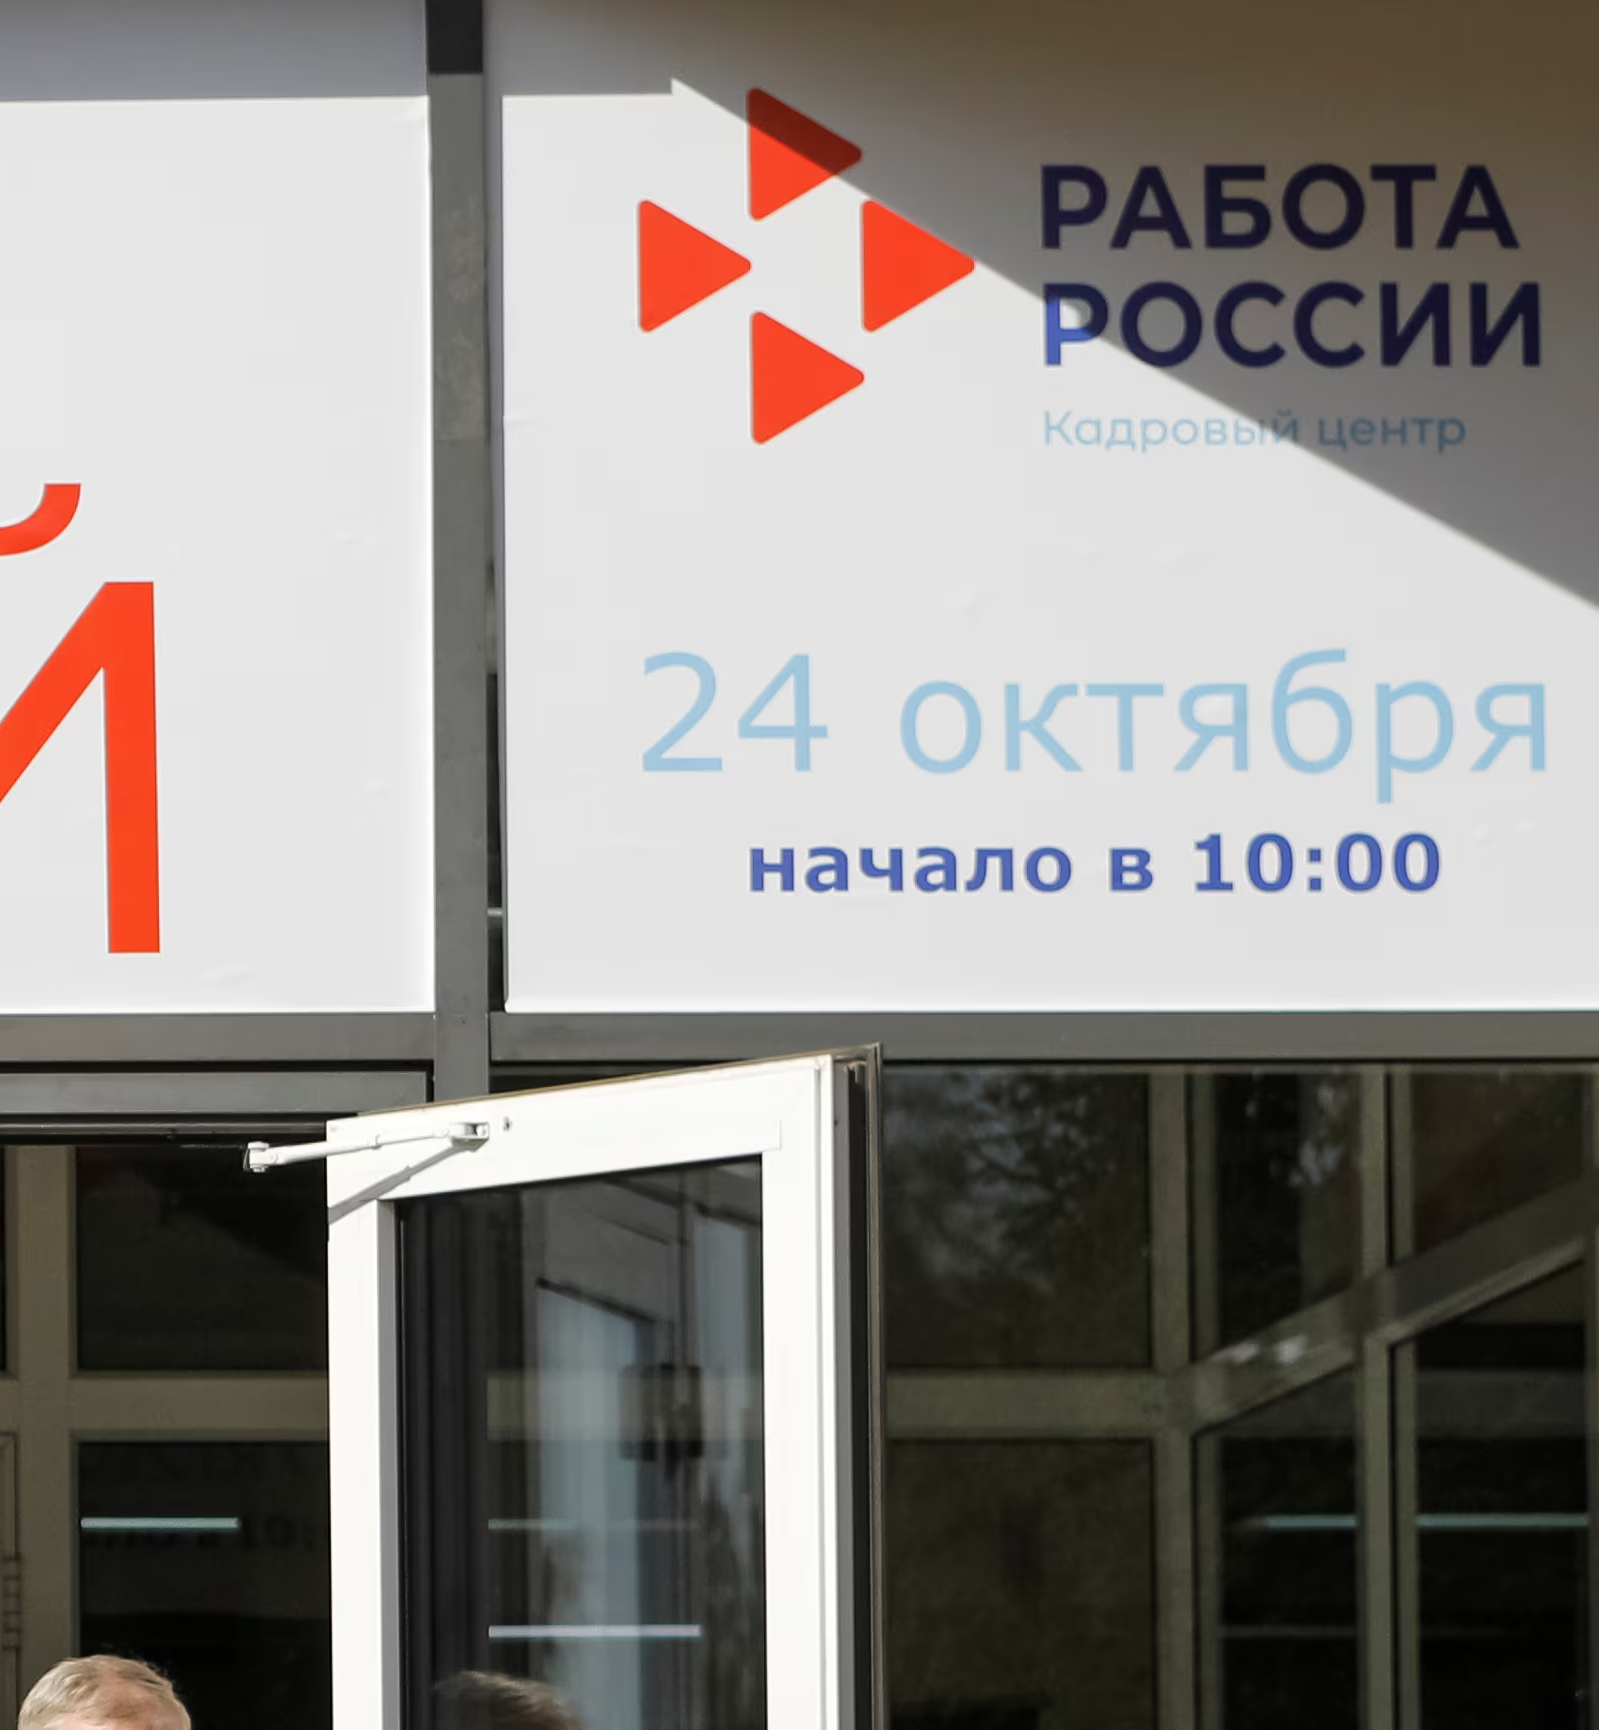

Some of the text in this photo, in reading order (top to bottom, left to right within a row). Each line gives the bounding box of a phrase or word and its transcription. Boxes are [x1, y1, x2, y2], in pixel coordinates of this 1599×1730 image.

[1040, 163, 1520, 250] РАБОТА
[1041, 281, 1542, 368] РОССИИ
[1043, 409, 1467, 453] Кадровый центр
[641, 647, 1548, 804] 24 октября
[749, 832, 1442, 894] начало в 10:00
